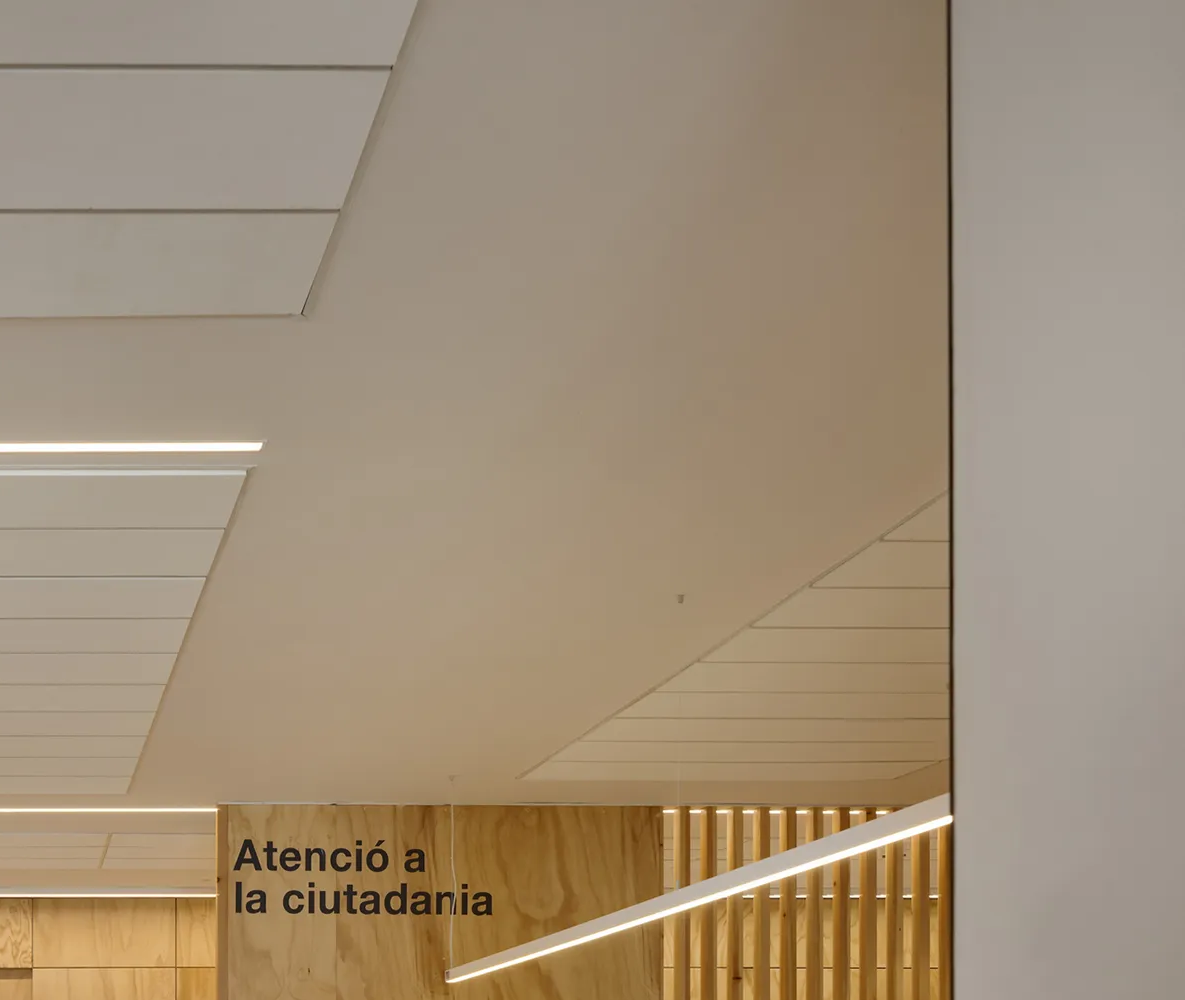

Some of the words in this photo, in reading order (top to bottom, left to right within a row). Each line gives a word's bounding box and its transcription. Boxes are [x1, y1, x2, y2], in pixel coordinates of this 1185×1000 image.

[232, 838, 390, 873] Atenció
[403, 848, 426, 873] a
[234, 881, 267, 915] la
[282, 882, 494, 917] ciutadania
